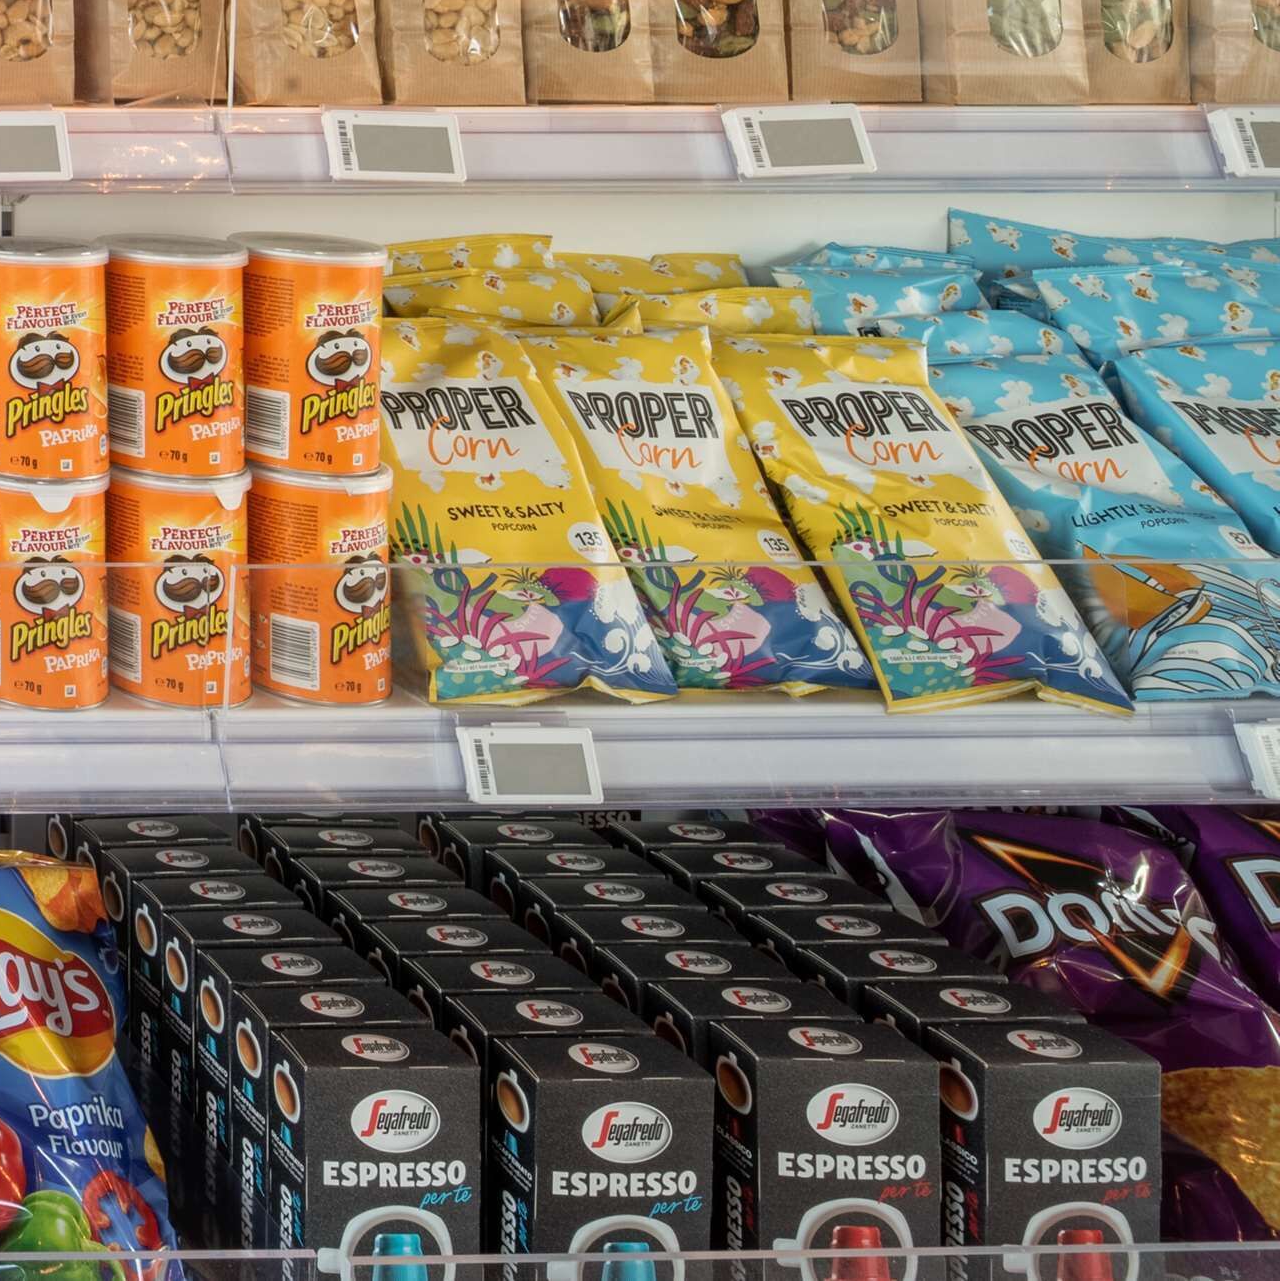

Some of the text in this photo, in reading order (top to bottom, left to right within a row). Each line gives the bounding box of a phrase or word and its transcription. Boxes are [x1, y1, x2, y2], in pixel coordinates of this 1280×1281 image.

[7, 317, 62, 329] FLAVOUR
[17, 304, 76, 318] PERFECT
[7, 382, 88, 438] Pringles
[156, 377, 233, 433] Pringles
[302, 378, 376, 434] Pringles
[380, 386, 537, 431] PROPER
[567, 389, 721, 440] PROPER
[782, 389, 951, 437] PROPER
[39, 424, 98, 447] PAPRIKA
[427, 416, 520, 466] Corn
[616, 423, 702, 469] Corn
[843, 424, 944, 467] Corn
[963, 402, 1139, 461] PROPER
[447, 504, 499, 521] SWEET
[516, 501, 568, 518] SALTY
[491, 521, 538, 532] POPCORN
[884, 500, 944, 517] SWEET
[934, 518, 978, 528] POPCORN
[1071, 504, 1137, 528] LIGHTLY
[574, 531, 603, 547] 135
[11, 606, 91, 662] Pringles
[44, 649, 101, 673] PAPRIKA
[28, 1096, 124, 1138] Paprika
[361, 1099, 431, 1137] Segafredo
[591, 1111, 663, 1148] Segafredo
[816, 1093, 890, 1130] Segafredo
[1043, 1097, 1113, 1135] Segafredo
[48, 1134, 124, 1160] Flavour
[323, 1160, 466, 1188] ESPRESSO
[551, 1170, 697, 1197] ESPRESSO
[777, 1151, 926, 1181] ESPRESSO
[1004, 1156, 1147, 1184] ESPRESSO
